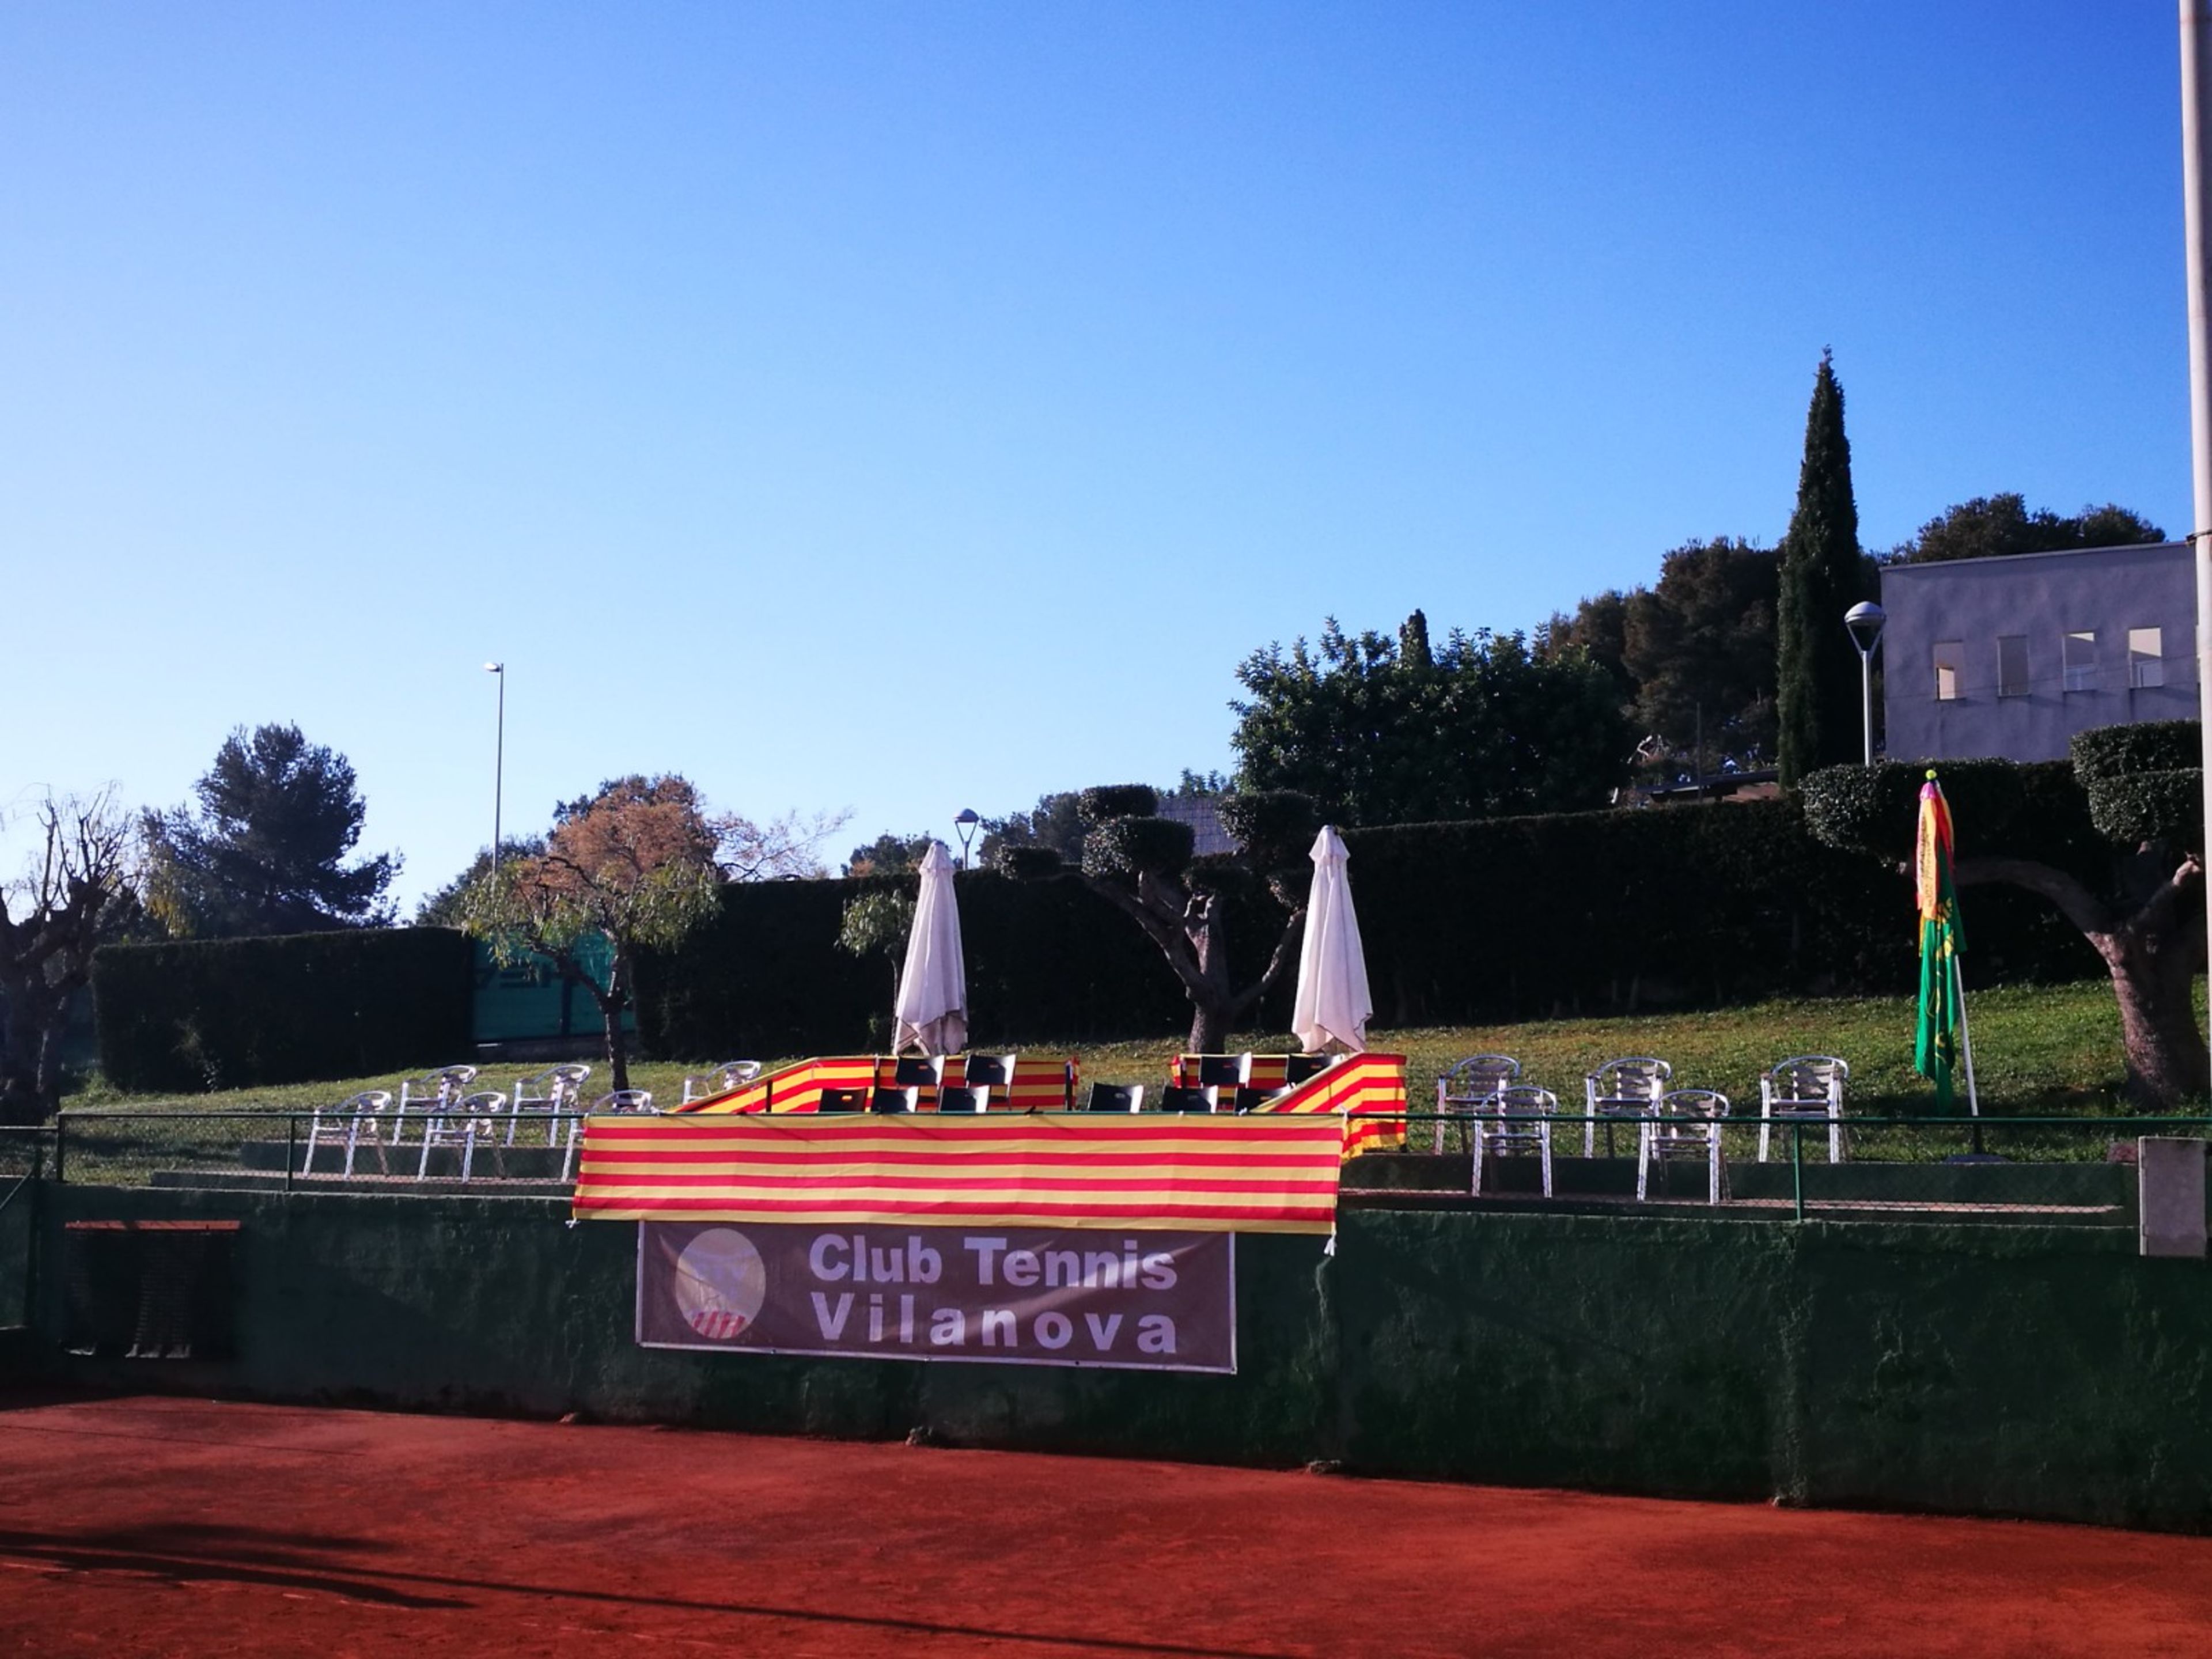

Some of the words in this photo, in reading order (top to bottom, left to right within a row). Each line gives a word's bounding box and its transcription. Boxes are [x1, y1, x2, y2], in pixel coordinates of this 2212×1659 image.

[809, 1233, 942, 1284] Club
[964, 1237, 1177, 1290] Tennis
[810, 1292, 1176, 1354] Vilanova
